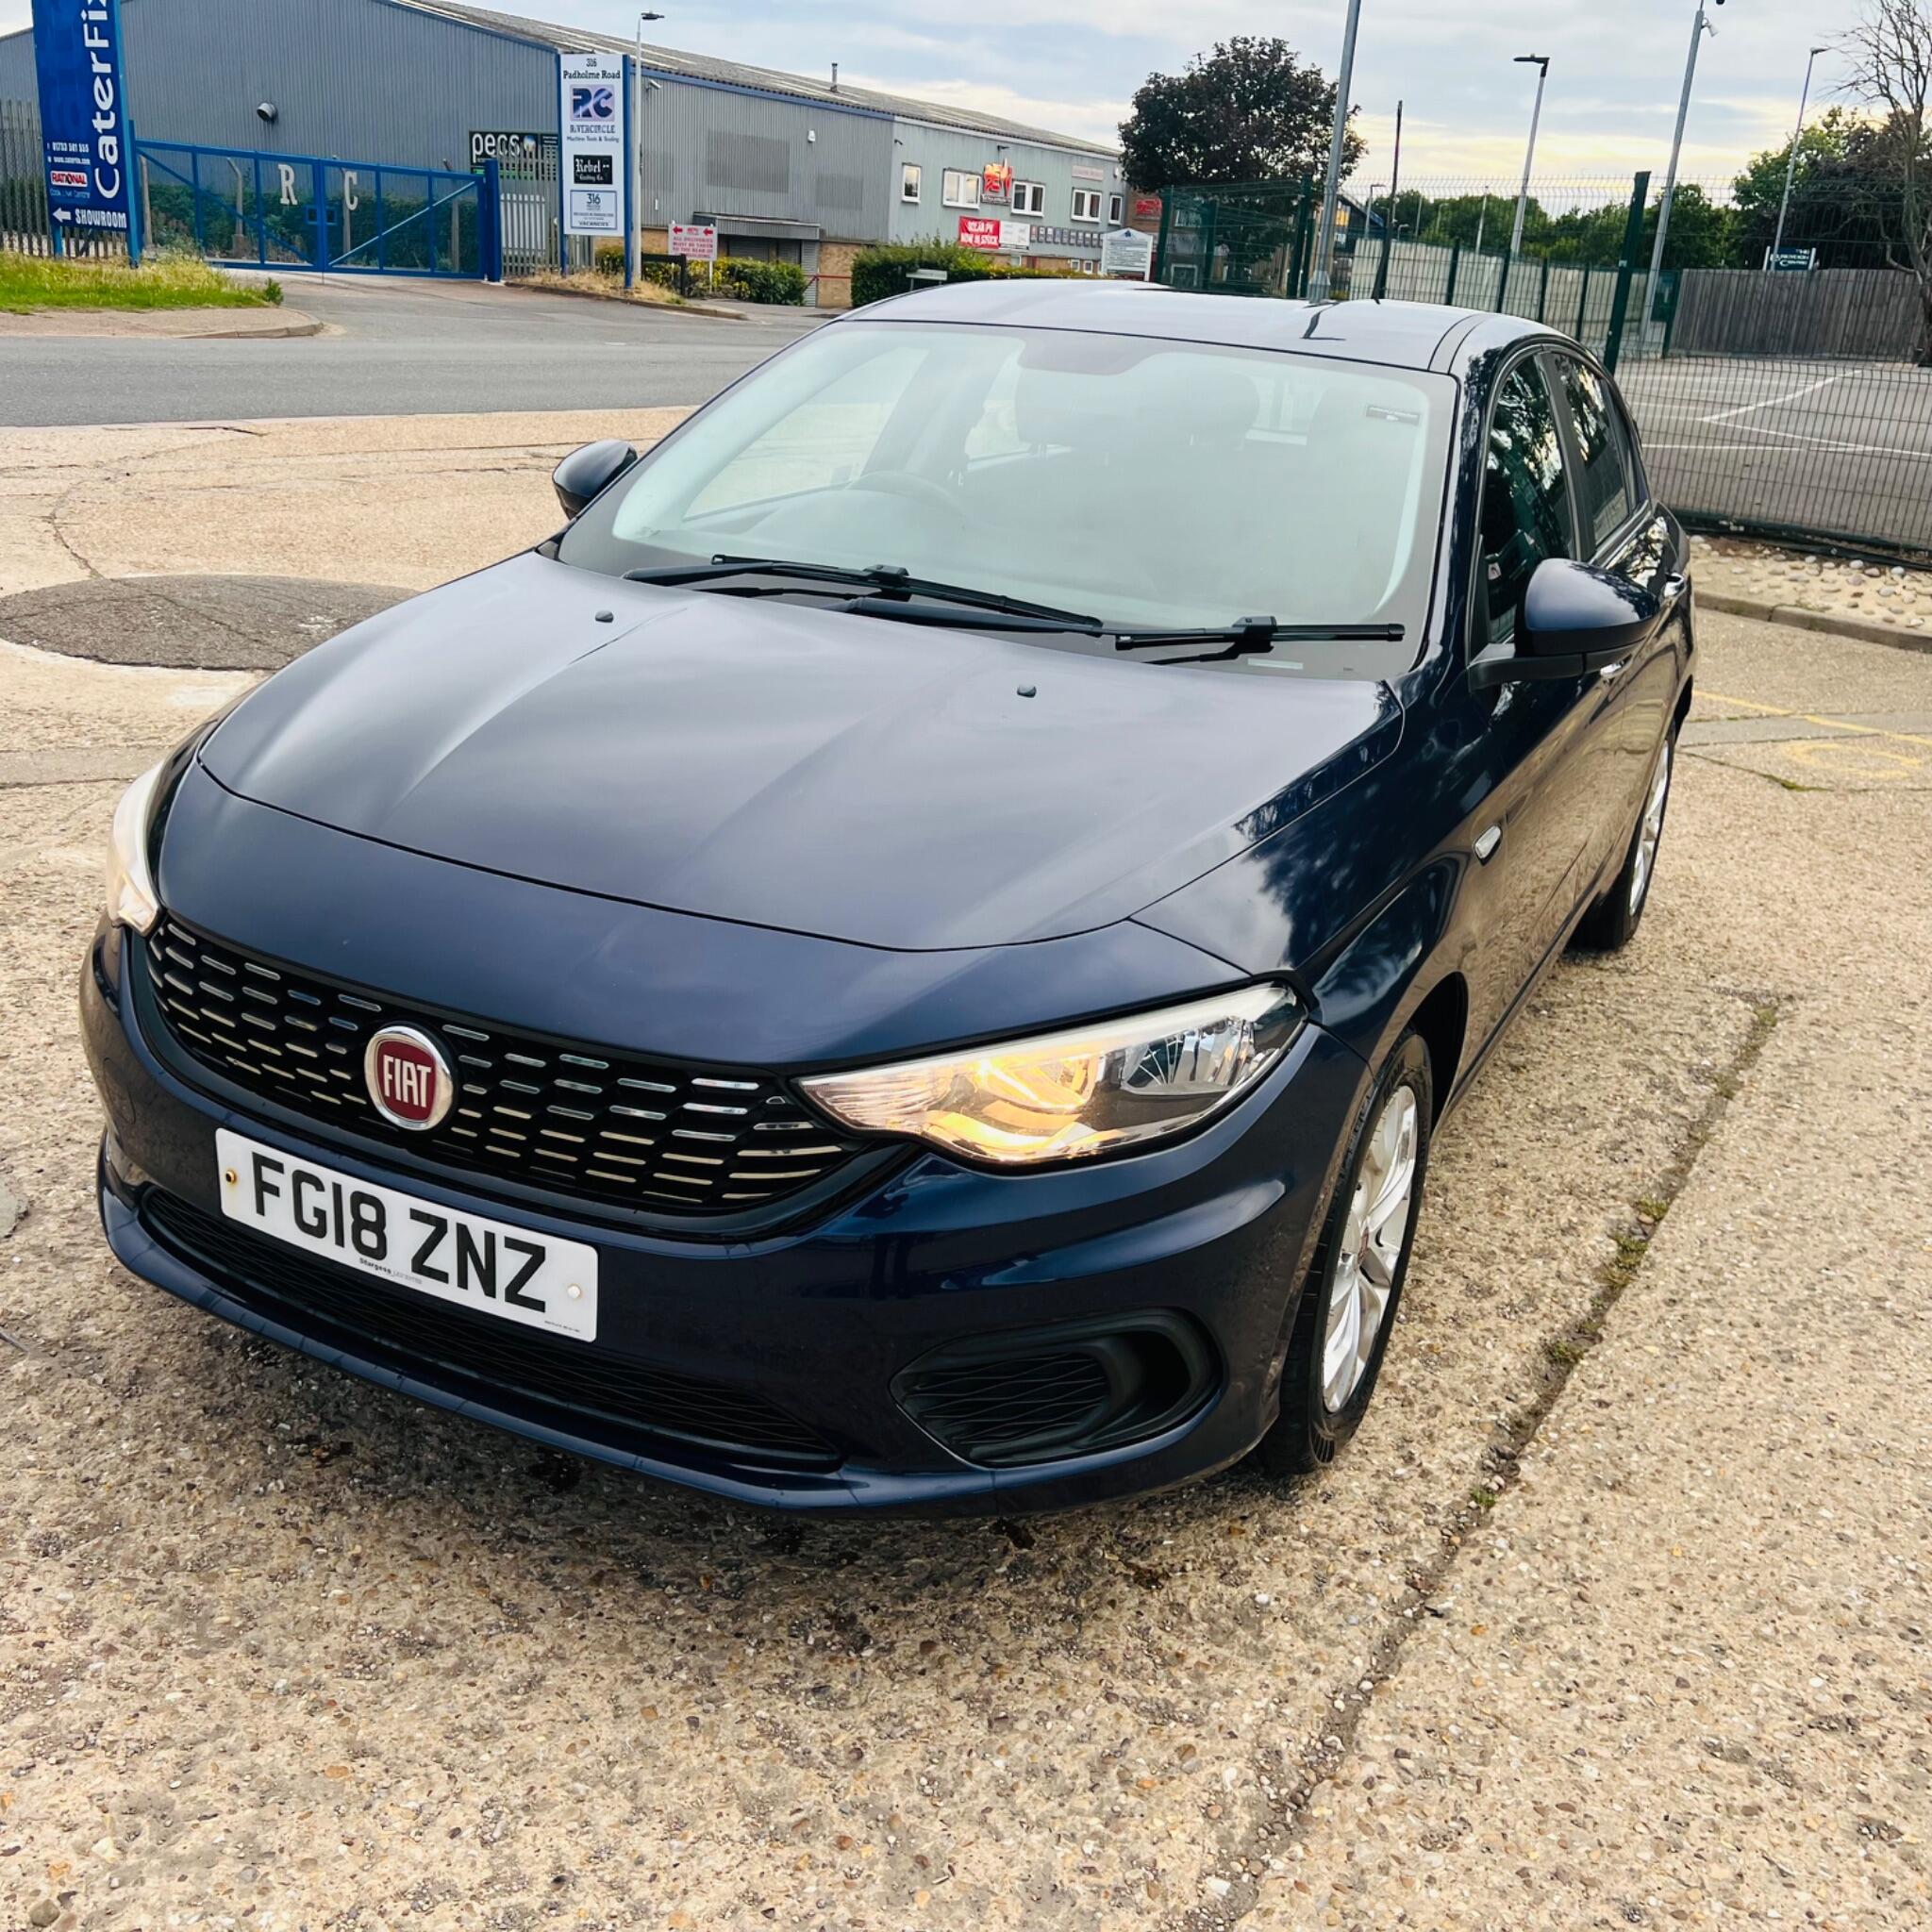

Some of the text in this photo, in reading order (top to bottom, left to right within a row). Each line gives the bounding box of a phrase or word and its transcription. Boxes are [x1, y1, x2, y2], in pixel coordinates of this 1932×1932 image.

[563, 70, 621, 79] Padholme Road
[573, 87, 613, 118] RC
[575, 158, 601, 173] Rebel
[52, 173, 87, 185] RATIONAL
[278, 163, 358, 210] R C
[587, 193, 601, 205] 316
[75, 208, 127, 228] SHOWROOM
[383, 1055, 433, 1108] FIAT
[252, 1152, 547, 1313] FG18 ZNZ
